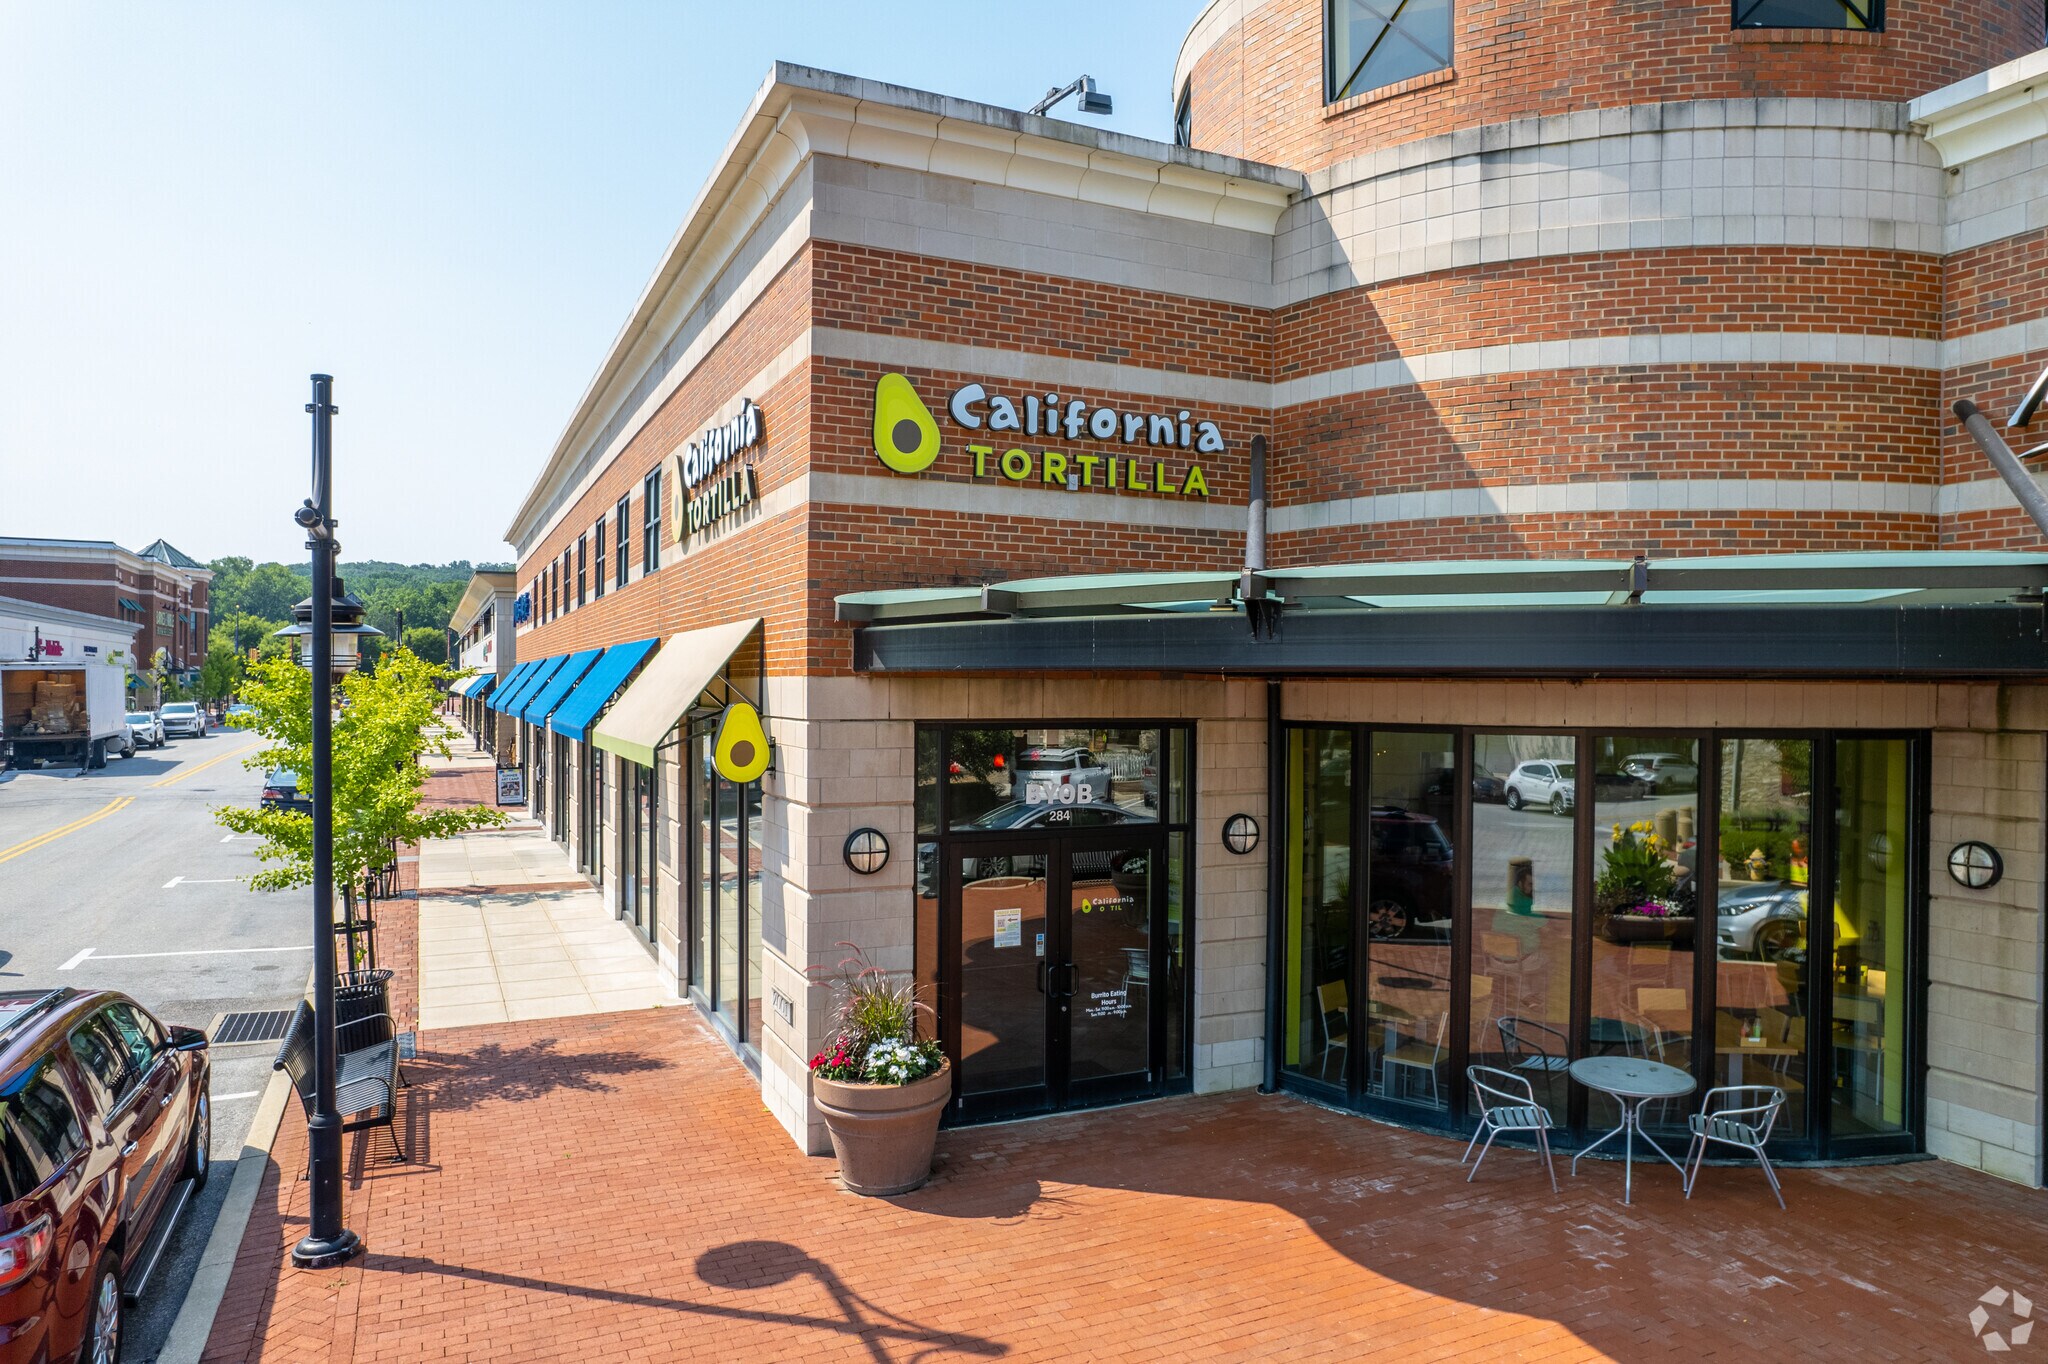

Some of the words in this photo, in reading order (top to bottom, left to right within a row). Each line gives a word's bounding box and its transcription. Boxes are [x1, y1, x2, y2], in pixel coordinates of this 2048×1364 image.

[684, 397, 762, 489] California
[950, 382, 1225, 453] California
[965, 443, 1209, 496] TORTILLA
[687, 463, 756, 534] TORTILLA
[1026, 783, 1092, 805] BYOB
[1049, 810, 1070, 821] 284
[1092, 896, 1134, 905] California
